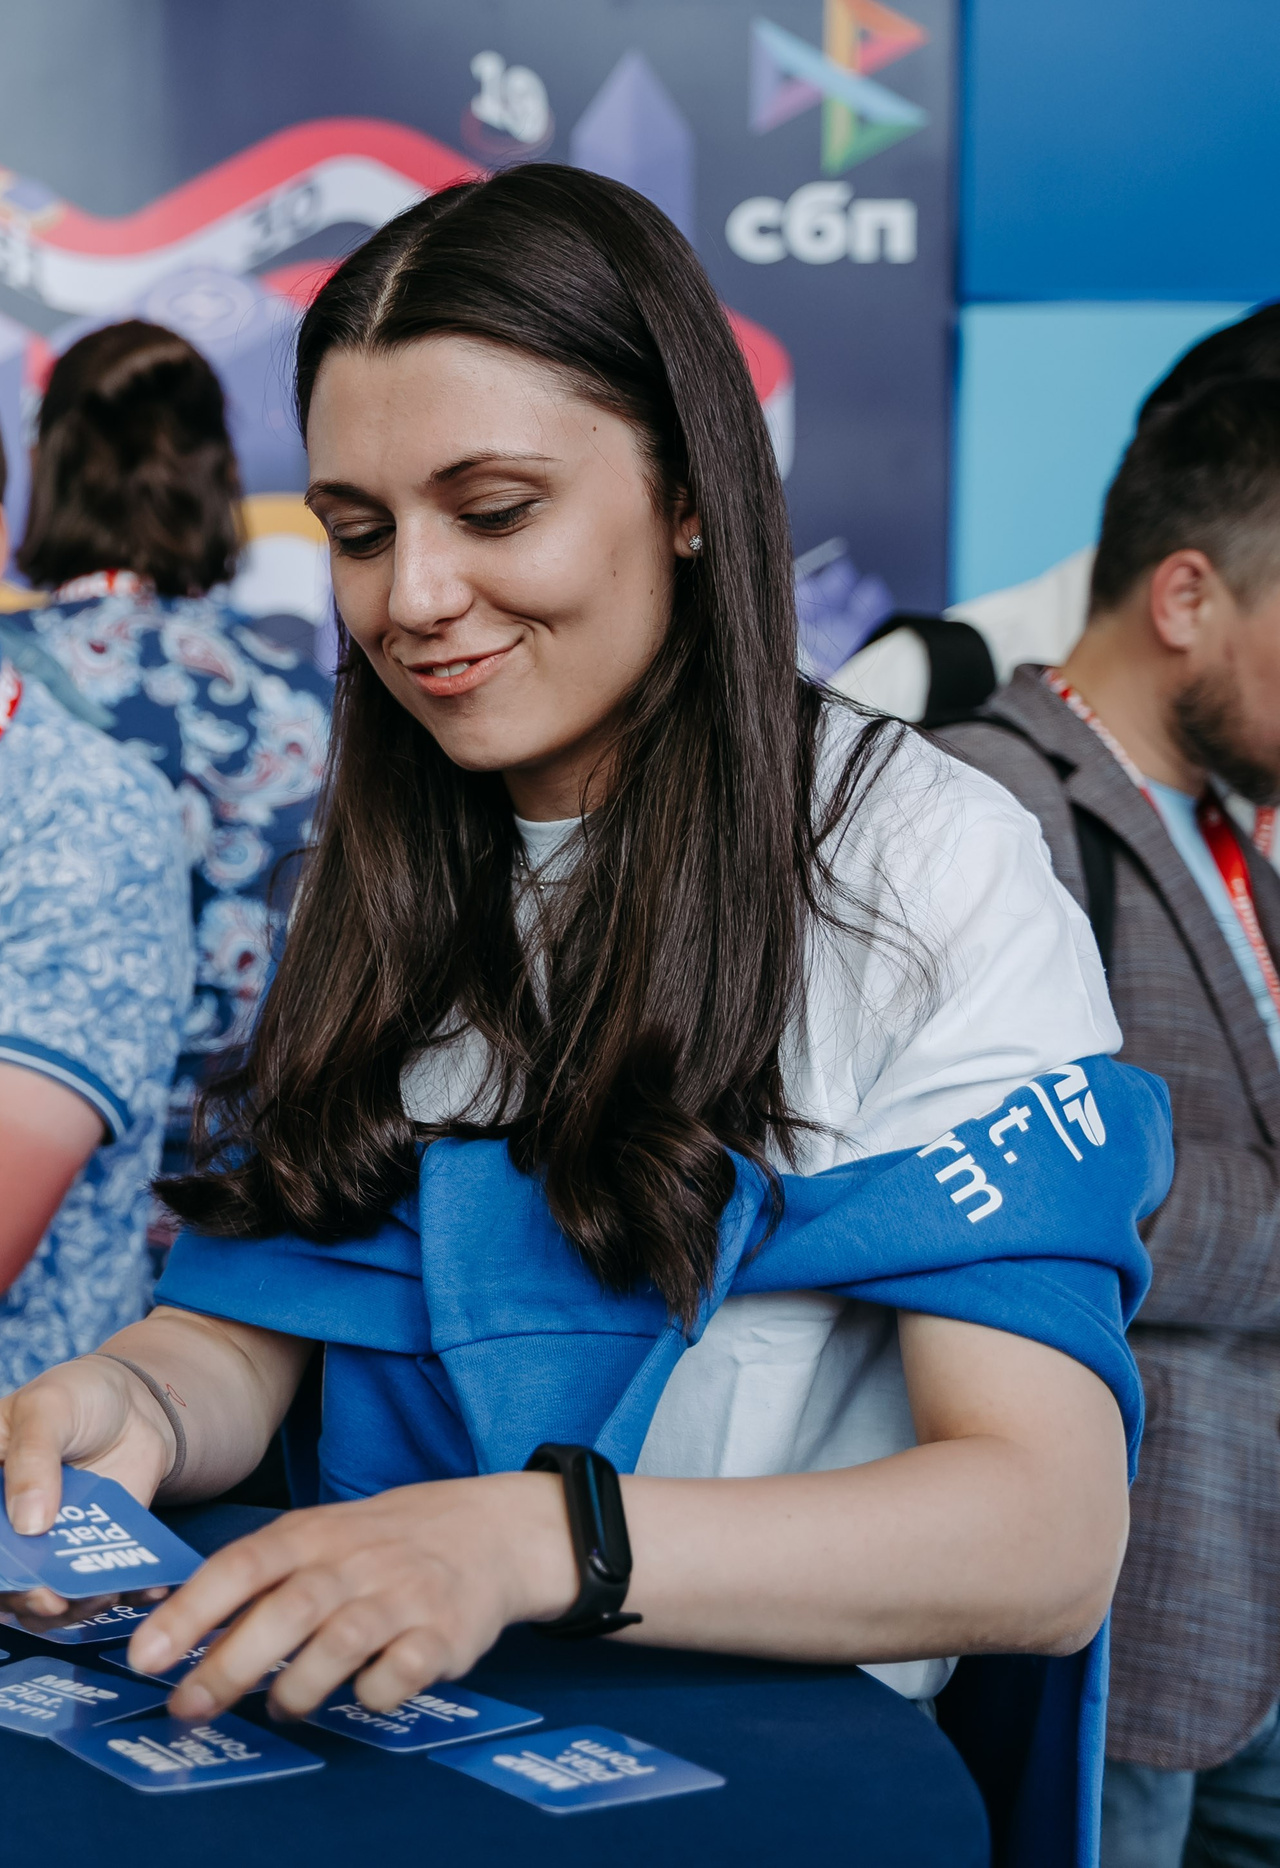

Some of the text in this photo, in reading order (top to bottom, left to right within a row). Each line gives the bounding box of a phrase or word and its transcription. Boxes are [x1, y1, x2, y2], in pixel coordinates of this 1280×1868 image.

[726, 180, 917, 264] сбп
[48, 1522, 131, 1546] Plat.
[327, 1703, 411, 1735] Form
[190, 1726, 262, 1761] Form
[571, 1739, 657, 1776] Form
